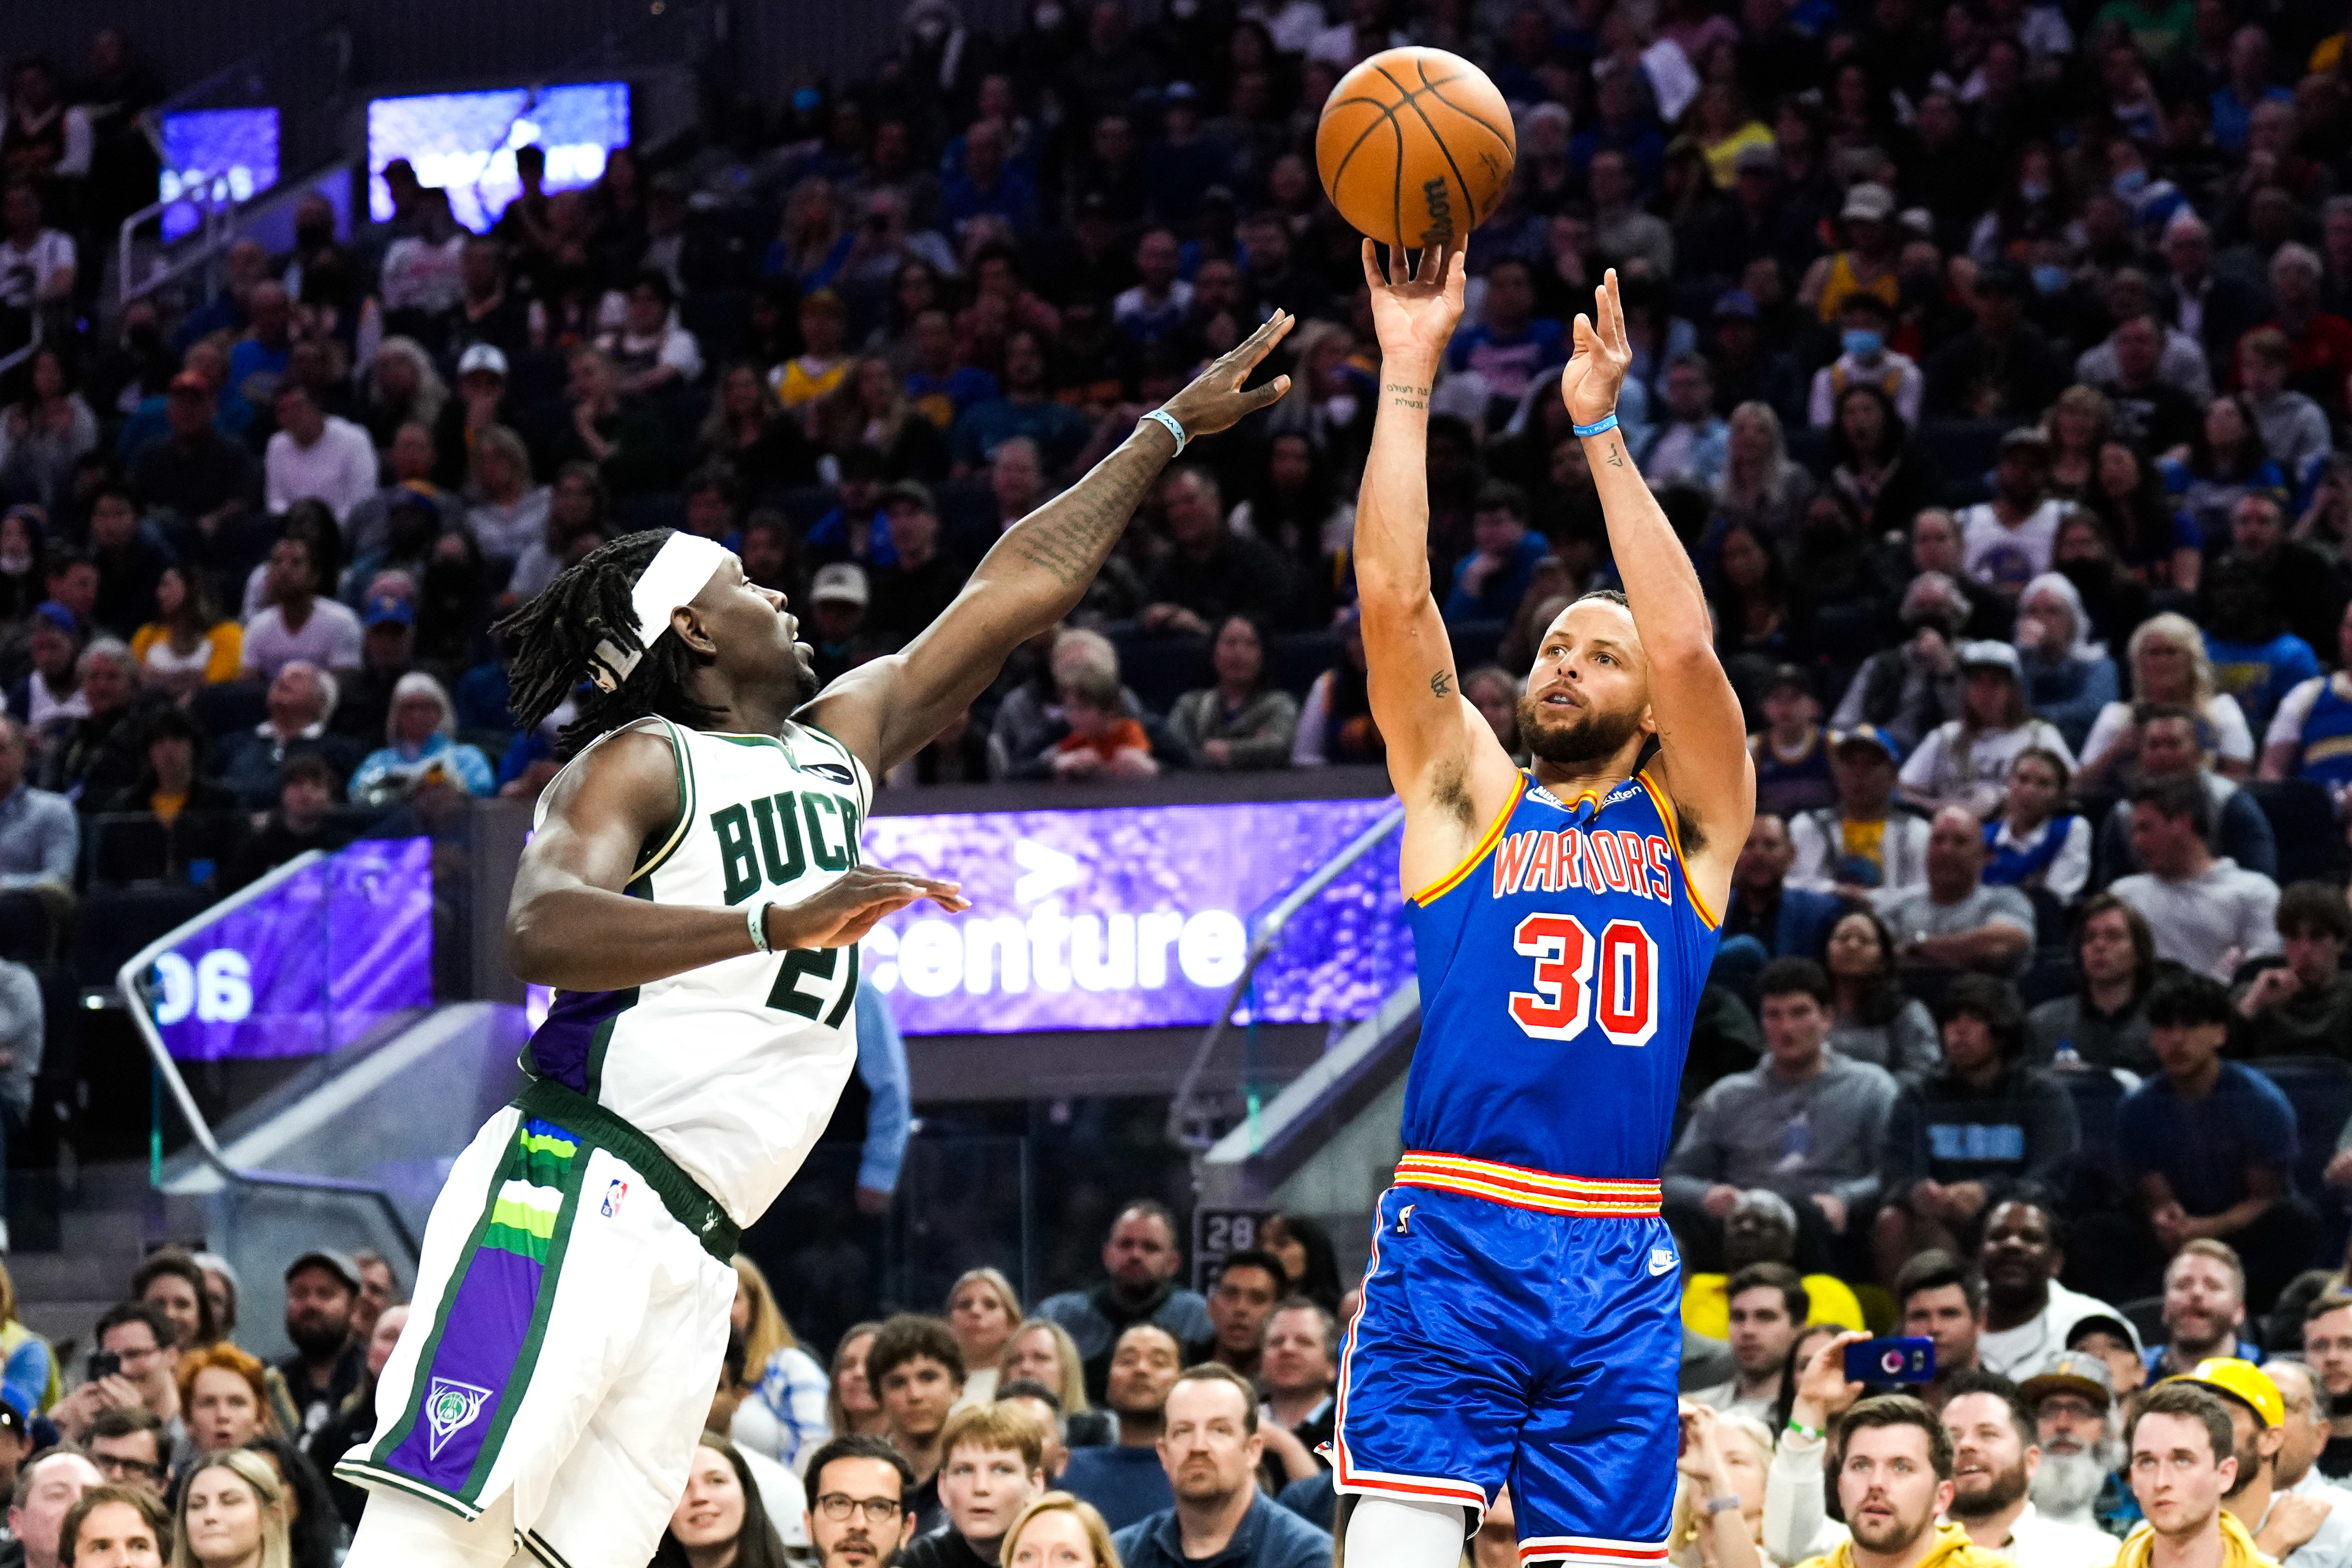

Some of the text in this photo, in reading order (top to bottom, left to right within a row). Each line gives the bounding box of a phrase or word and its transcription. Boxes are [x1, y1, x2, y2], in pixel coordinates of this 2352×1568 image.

[1534, 785, 1564, 806] NIKE
[1508, 912, 1658, 1047] 30
[1208, 1216, 1254, 1250] 28
[1651, 1249, 1673, 1265] NIKE
